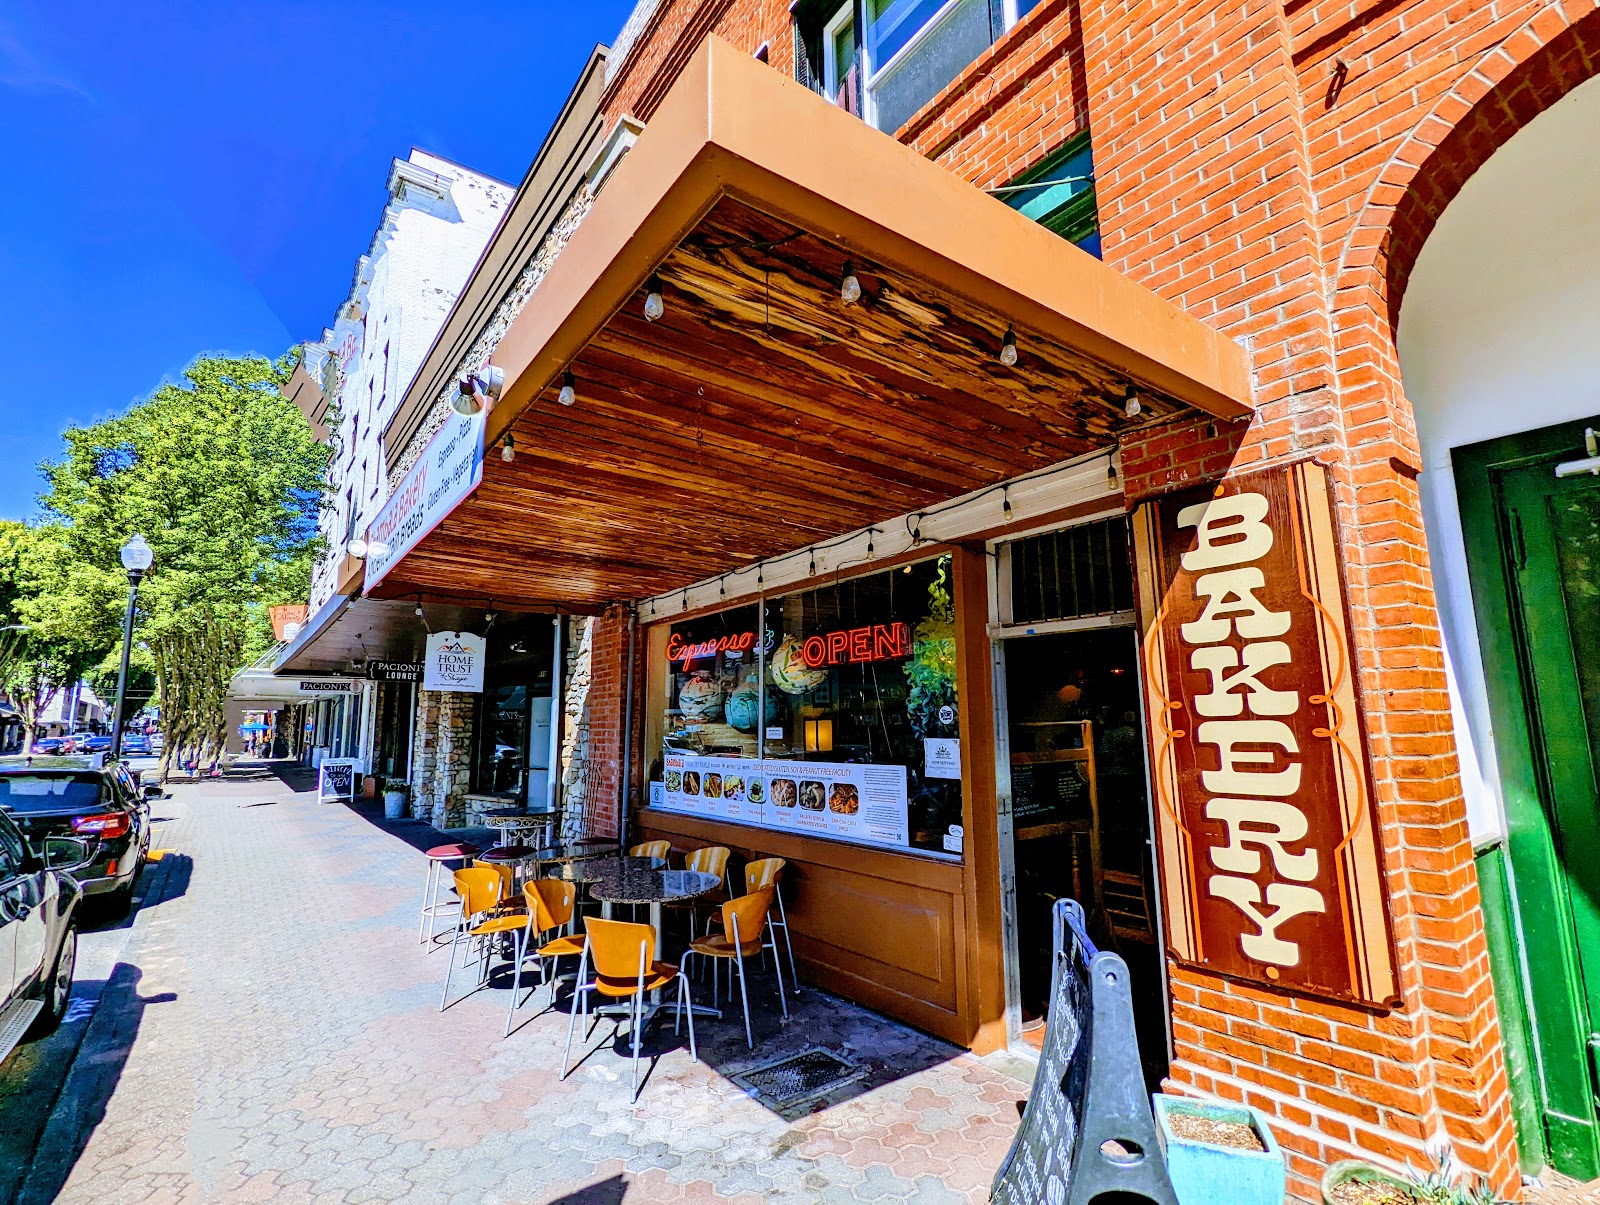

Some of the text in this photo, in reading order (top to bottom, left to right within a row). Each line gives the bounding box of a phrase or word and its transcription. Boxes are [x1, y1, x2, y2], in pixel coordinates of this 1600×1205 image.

[437, 416, 472, 470] Espresso Pizza
[427, 484, 441, 512] Gluten
[452, 444, 479, 490] Vegetarian
[802, 621, 906, 668] OPEN
[666, 631, 755, 673] Espresso
[438, 654, 474, 665] HOME
[378, 662, 426, 673] PACIONI'S
[437, 664, 474, 674] TRUST
[385, 671, 418, 680] LOUNGE
[303, 682, 350, 691] PACIONI'S
[1177, 491, 1326, 967] BAKERY
[803, 767, 821, 775] PEANUT
[820, 768, 832, 776] FREE
[831, 768, 852, 777] FACILITY
[324, 777, 350, 788] OPEN
